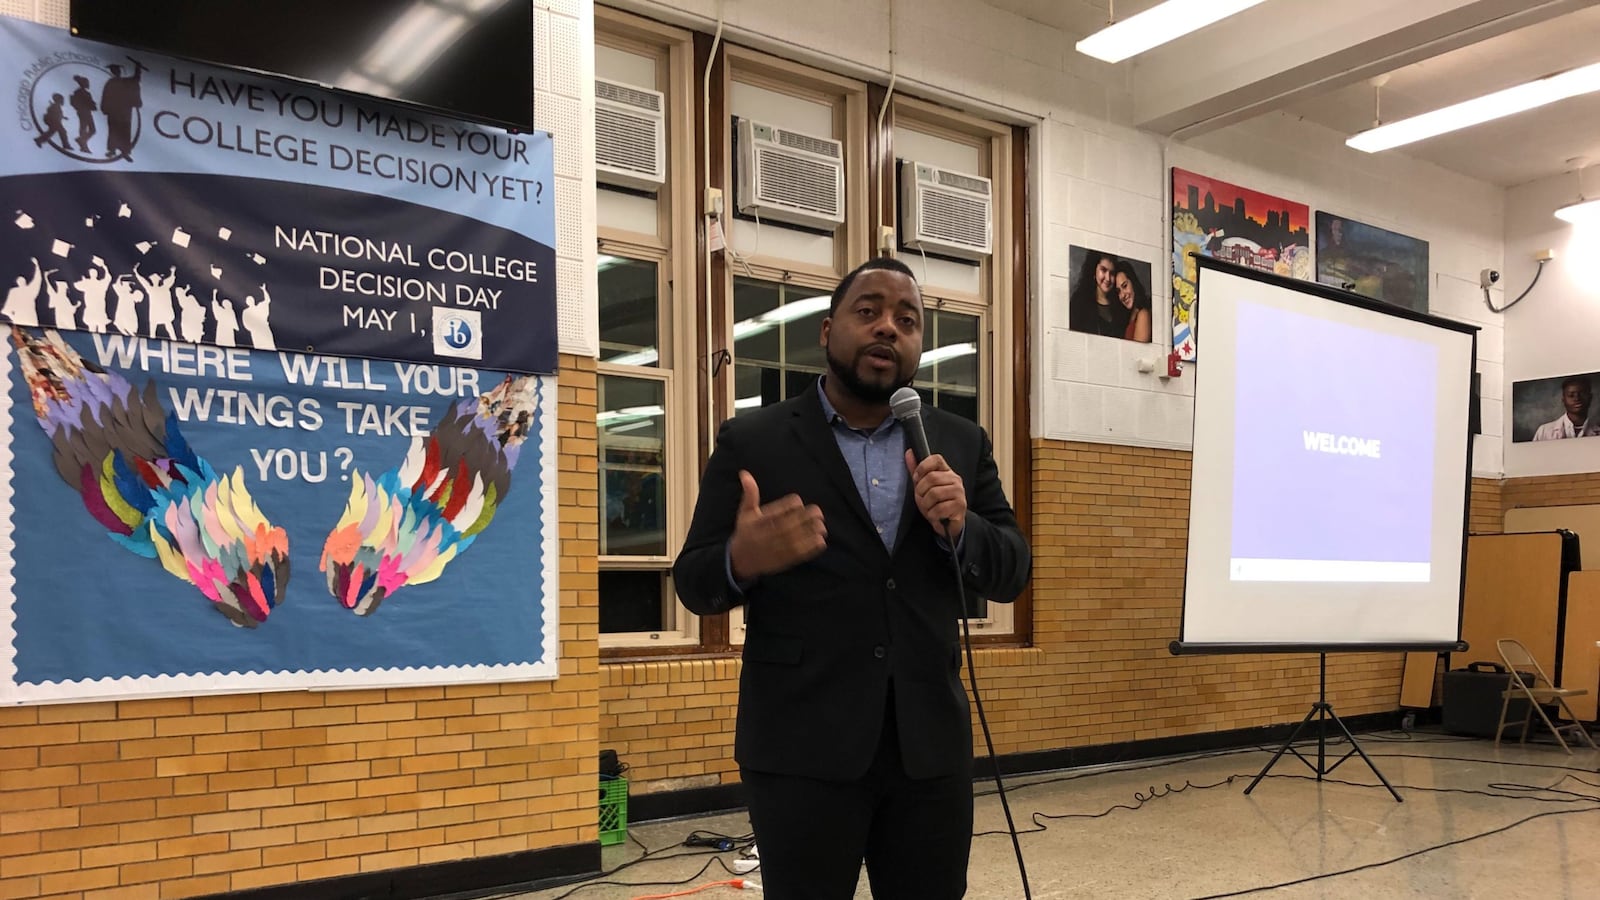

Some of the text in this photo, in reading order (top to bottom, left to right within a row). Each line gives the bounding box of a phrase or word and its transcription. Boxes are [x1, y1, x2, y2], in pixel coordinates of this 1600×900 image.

[23, 57, 54, 78] Public
[170, 68, 530, 166] HAVE YOU MADE YOUR
[153, 110, 543, 205] COLLEGE DECISION YET?
[274, 225, 538, 284] NATIONAL COLLEGE
[319, 267, 503, 311] DECISION DAY
[343, 304, 398, 332] MAY
[409, 312, 426, 337] 1,
[93, 333, 481, 398] WHERE WILL YOUR
[168, 387, 431, 438] WINGS TAKE
[1302, 429, 1382, 459] WELCOME
